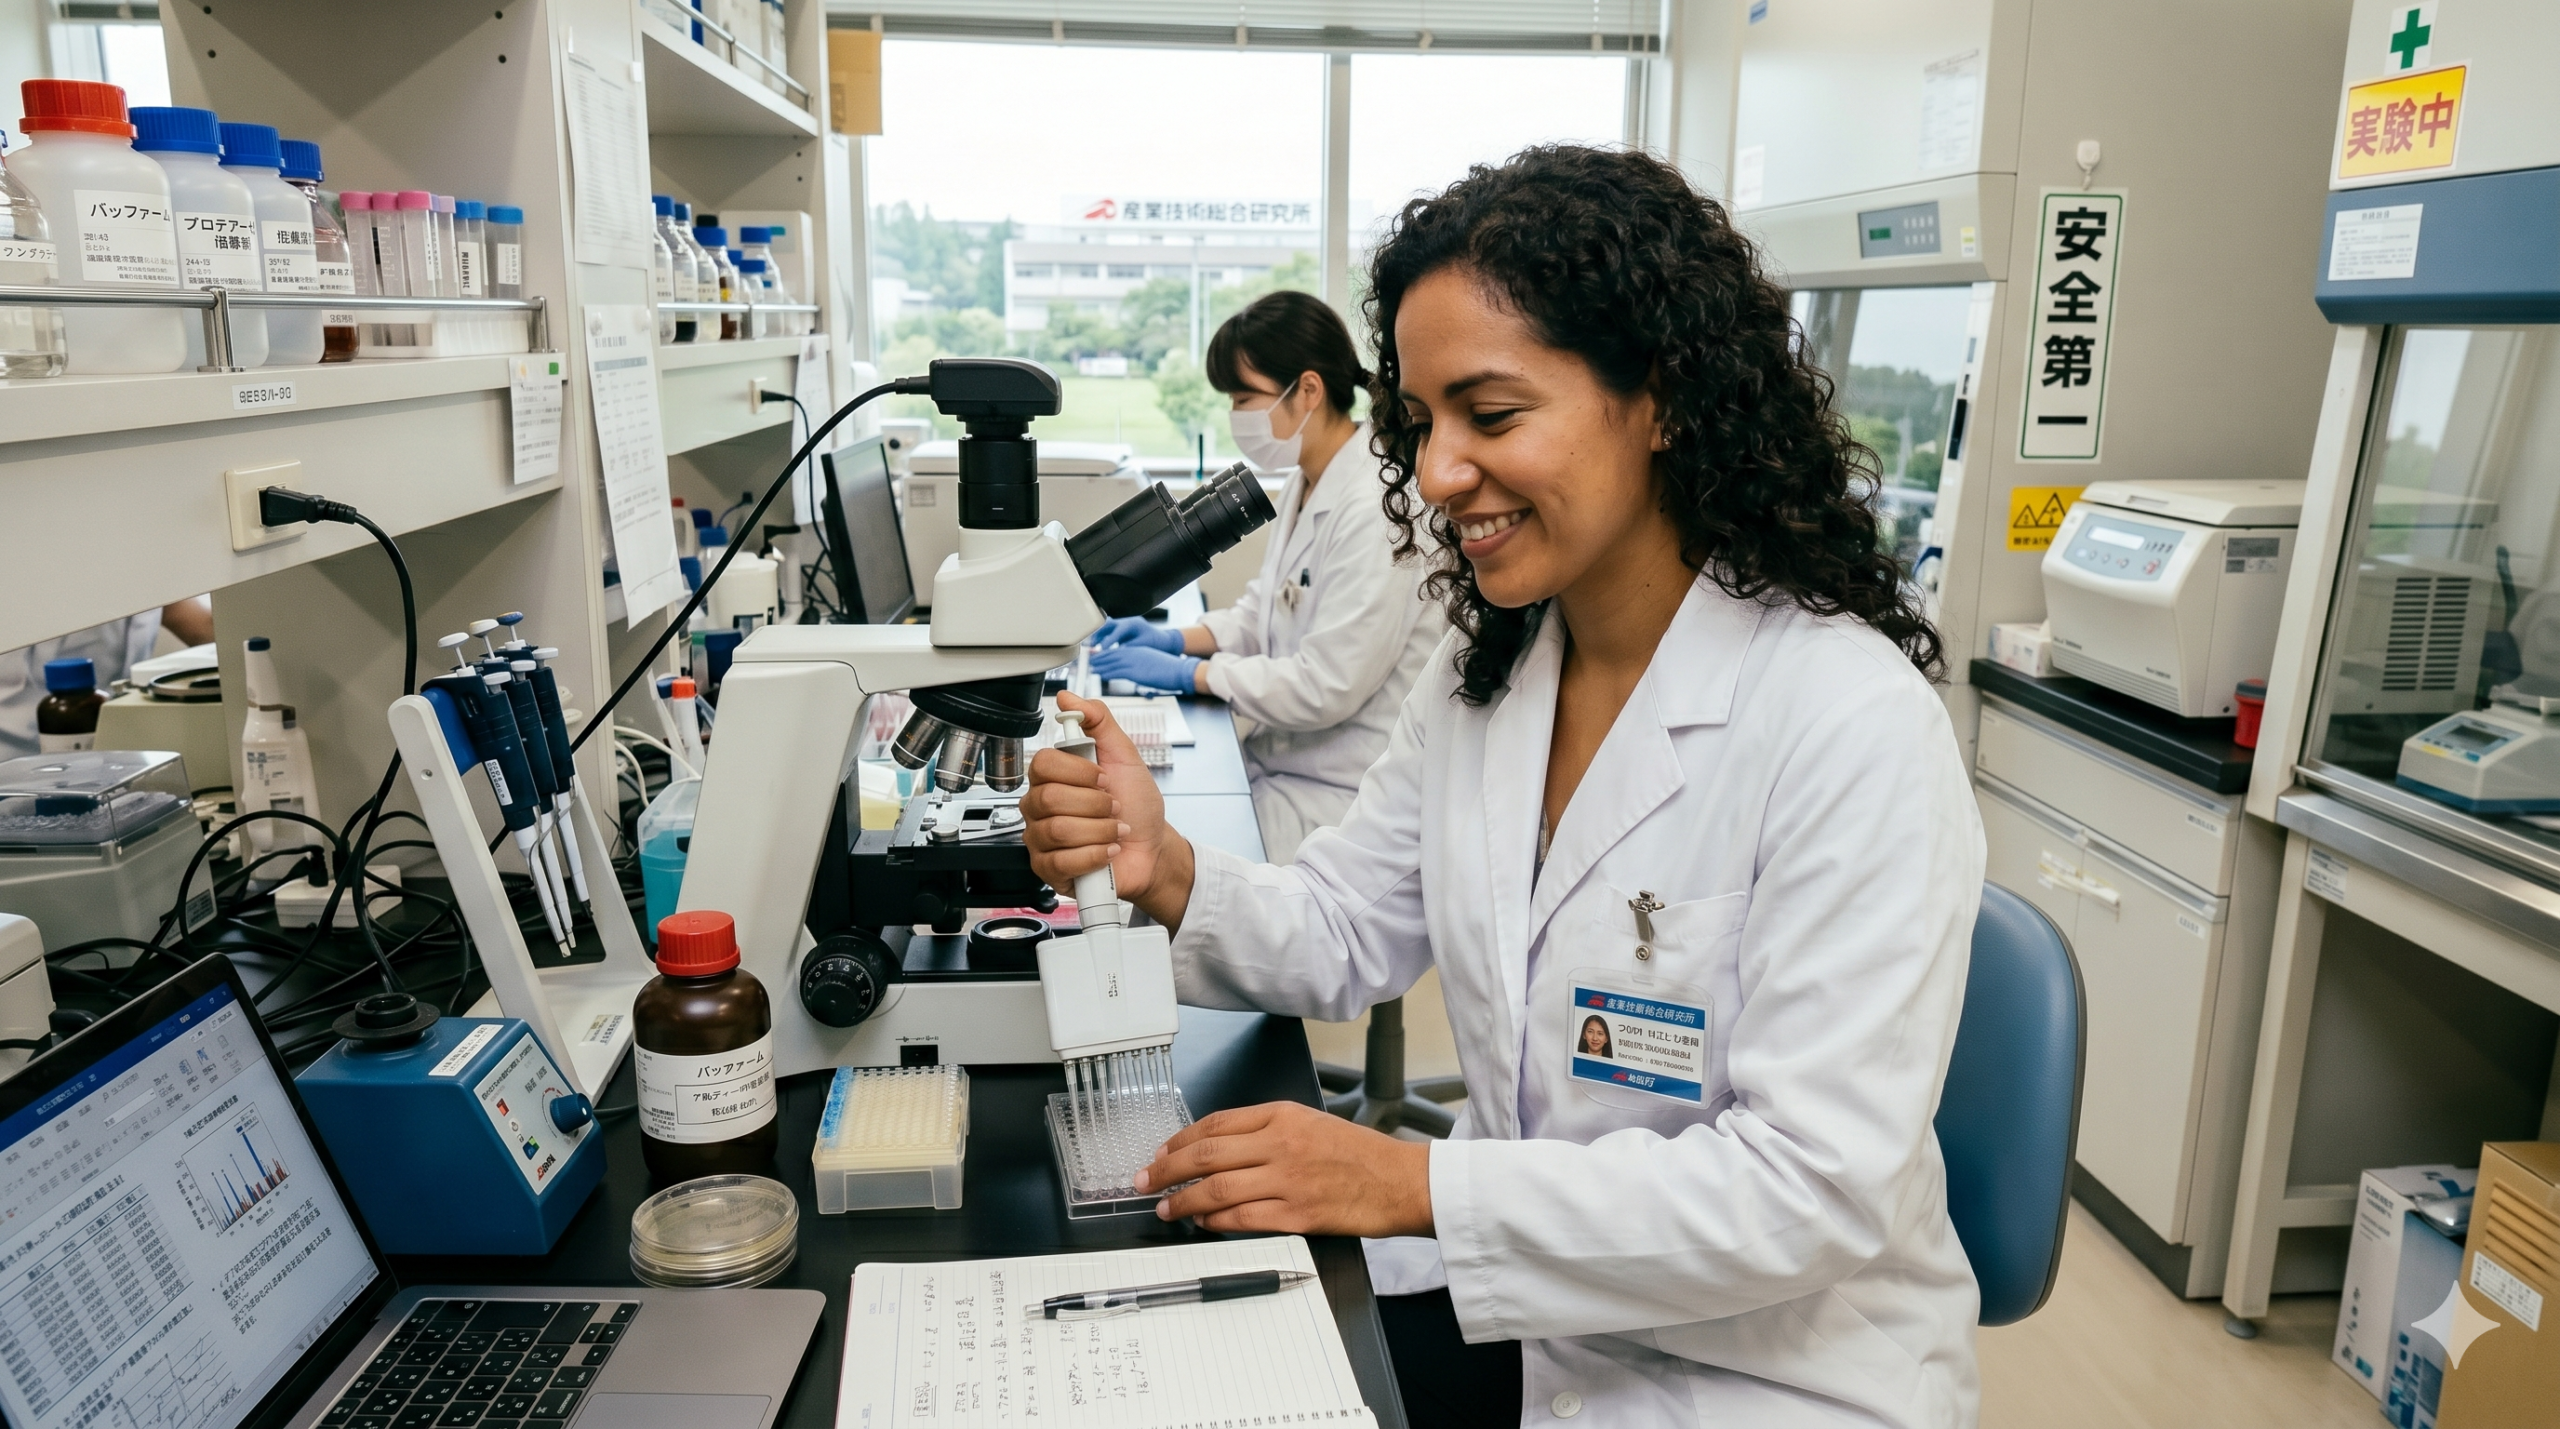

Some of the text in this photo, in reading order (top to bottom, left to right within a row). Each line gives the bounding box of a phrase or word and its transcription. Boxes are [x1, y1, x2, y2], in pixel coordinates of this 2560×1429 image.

[2347, 92, 2454, 160] 実験中
[1124, 202, 1310, 223] 産業技術総合研究所
[2037, 207, 2107, 425] 安全第一
